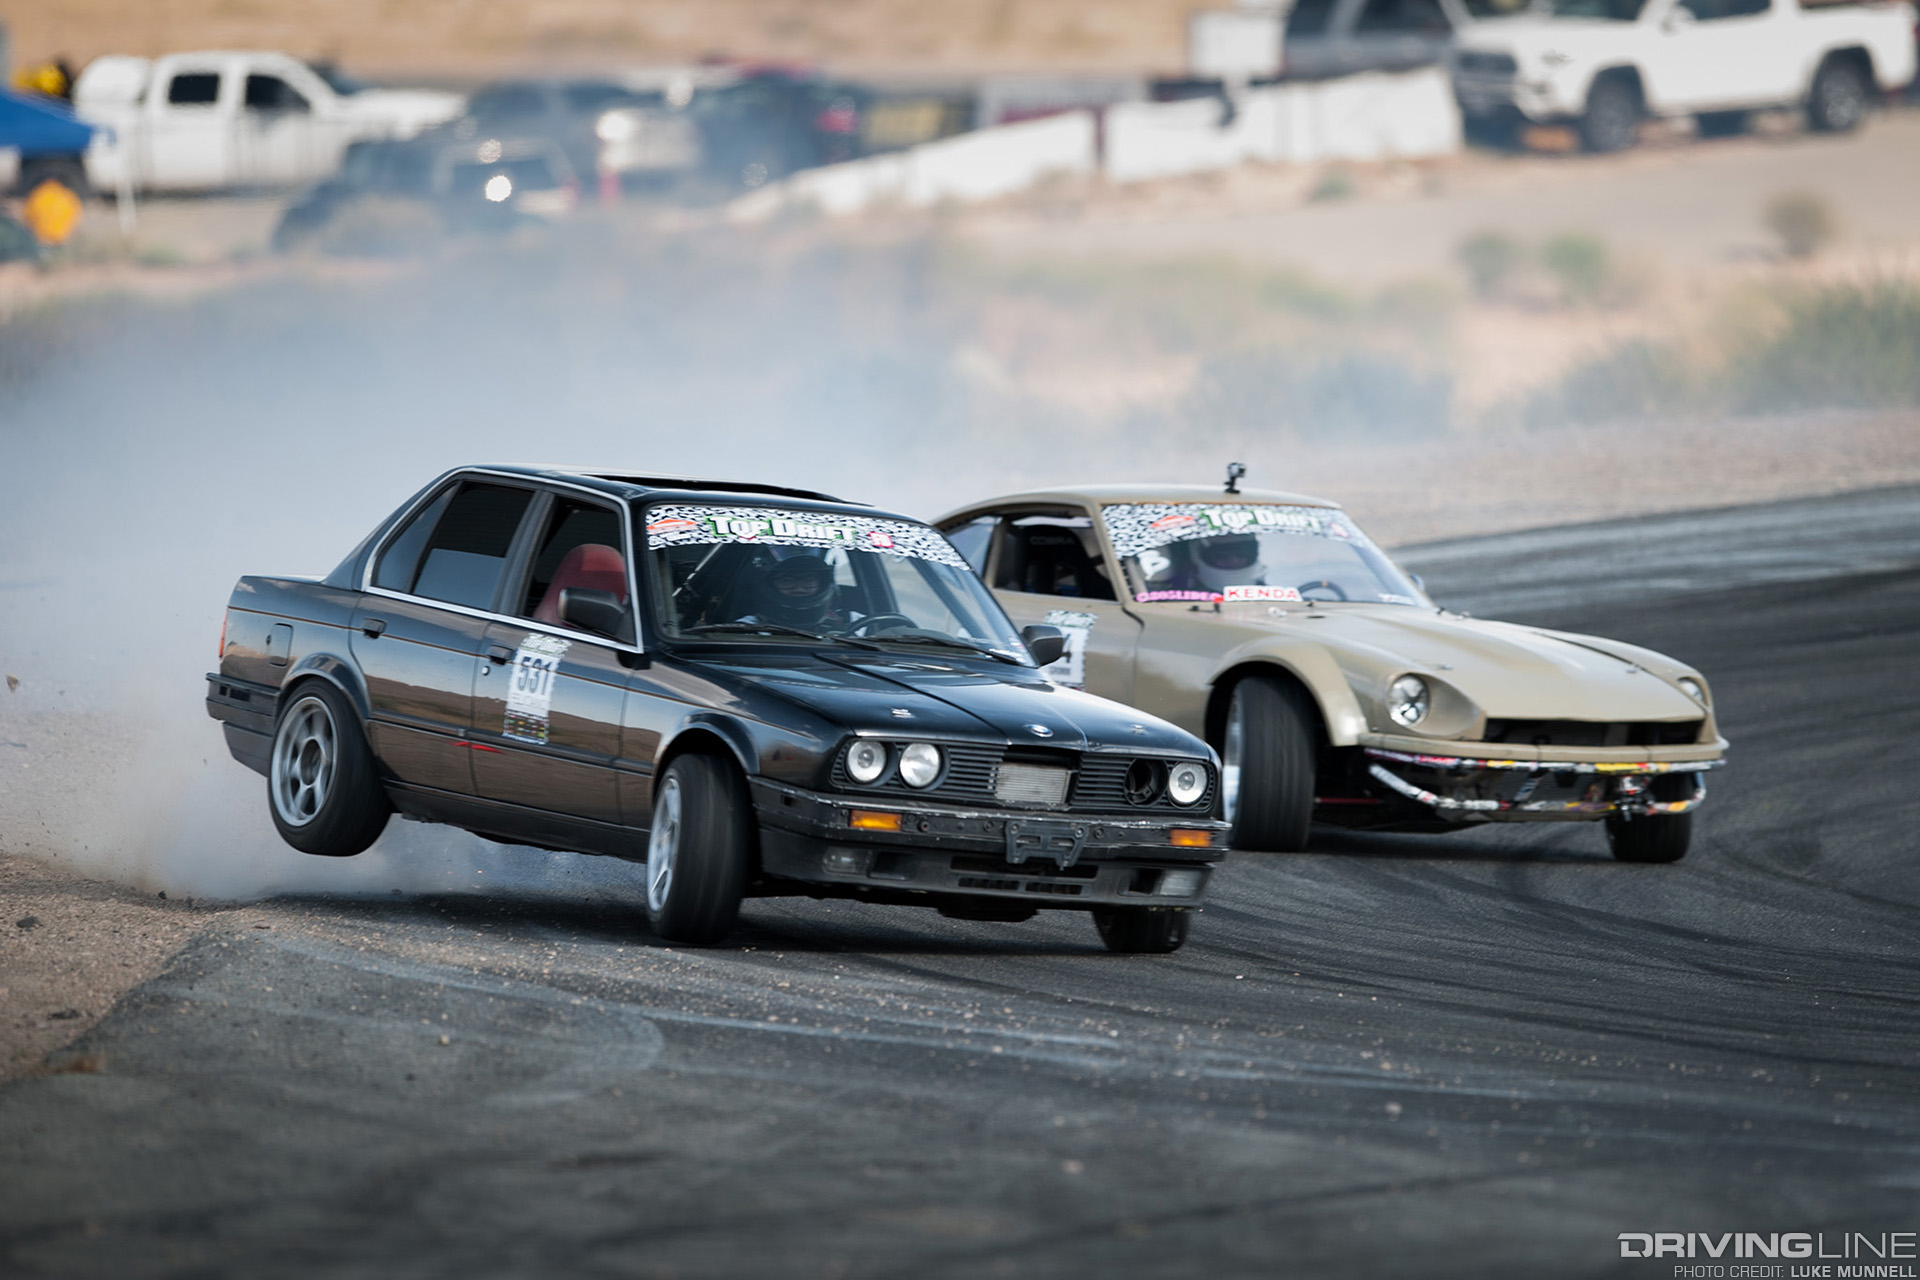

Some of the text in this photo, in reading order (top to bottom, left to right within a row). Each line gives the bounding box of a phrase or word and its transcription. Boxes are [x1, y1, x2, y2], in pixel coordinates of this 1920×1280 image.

[708, 516, 769, 537] TOP
[770, 518, 856, 542] DRIFT
[1204, 509, 1253, 528] TOP
[1253, 509, 1321, 530] DRIFT
[1228, 587, 1299, 600] KENDA
[518, 656, 552, 695] 531
